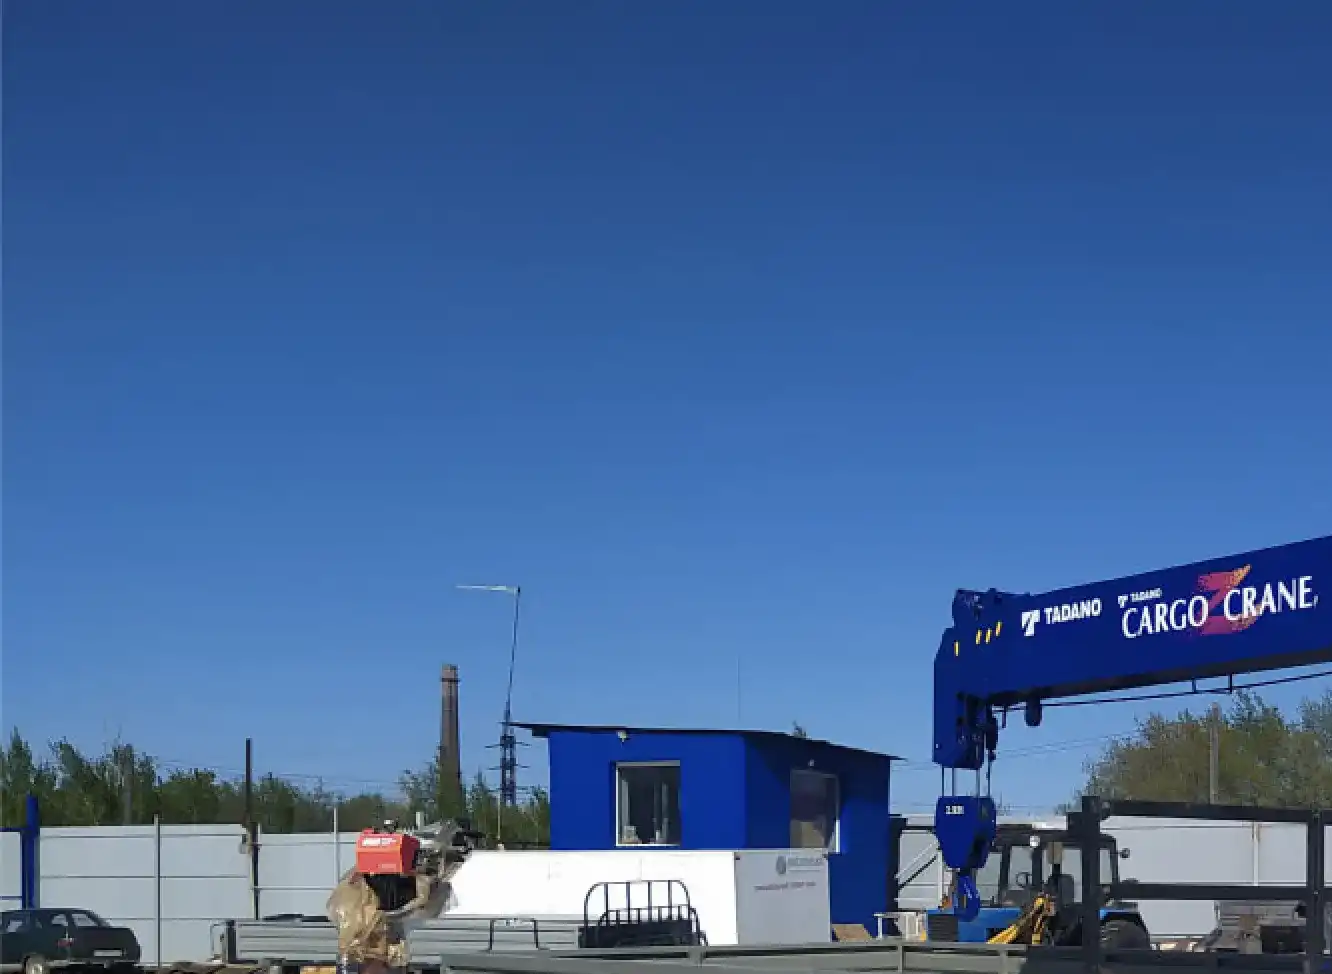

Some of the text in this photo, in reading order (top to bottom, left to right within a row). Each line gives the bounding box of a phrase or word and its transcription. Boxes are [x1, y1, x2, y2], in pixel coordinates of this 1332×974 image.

[1129, 587, 1163, 603] TADANO
[1044, 598, 1102, 624] TADANO
[1121, 595, 1209, 638] CARGO
